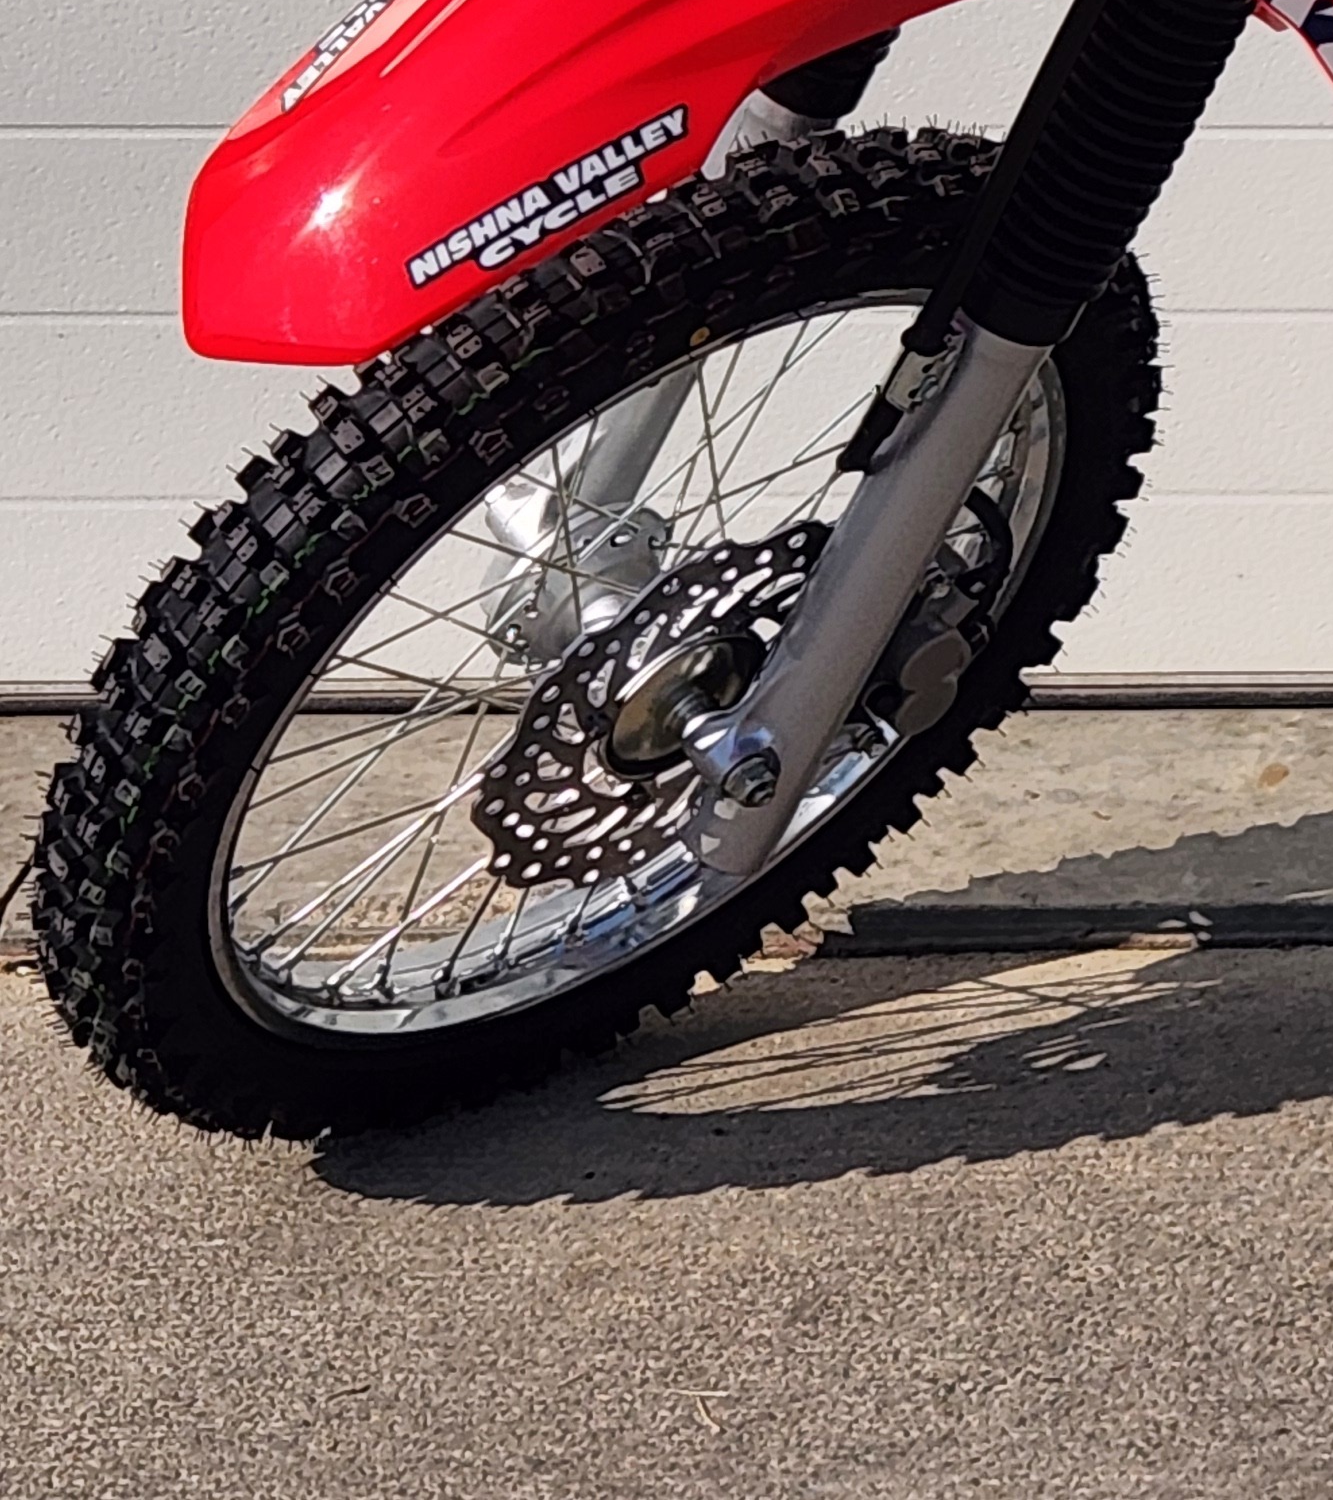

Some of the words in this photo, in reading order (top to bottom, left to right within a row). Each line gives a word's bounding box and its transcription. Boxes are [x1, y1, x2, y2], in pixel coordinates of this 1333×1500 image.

[408, 186, 551, 285] NISHNA
[553, 108, 685, 195] VALLEY
[479, 165, 641, 268] CYCLE
